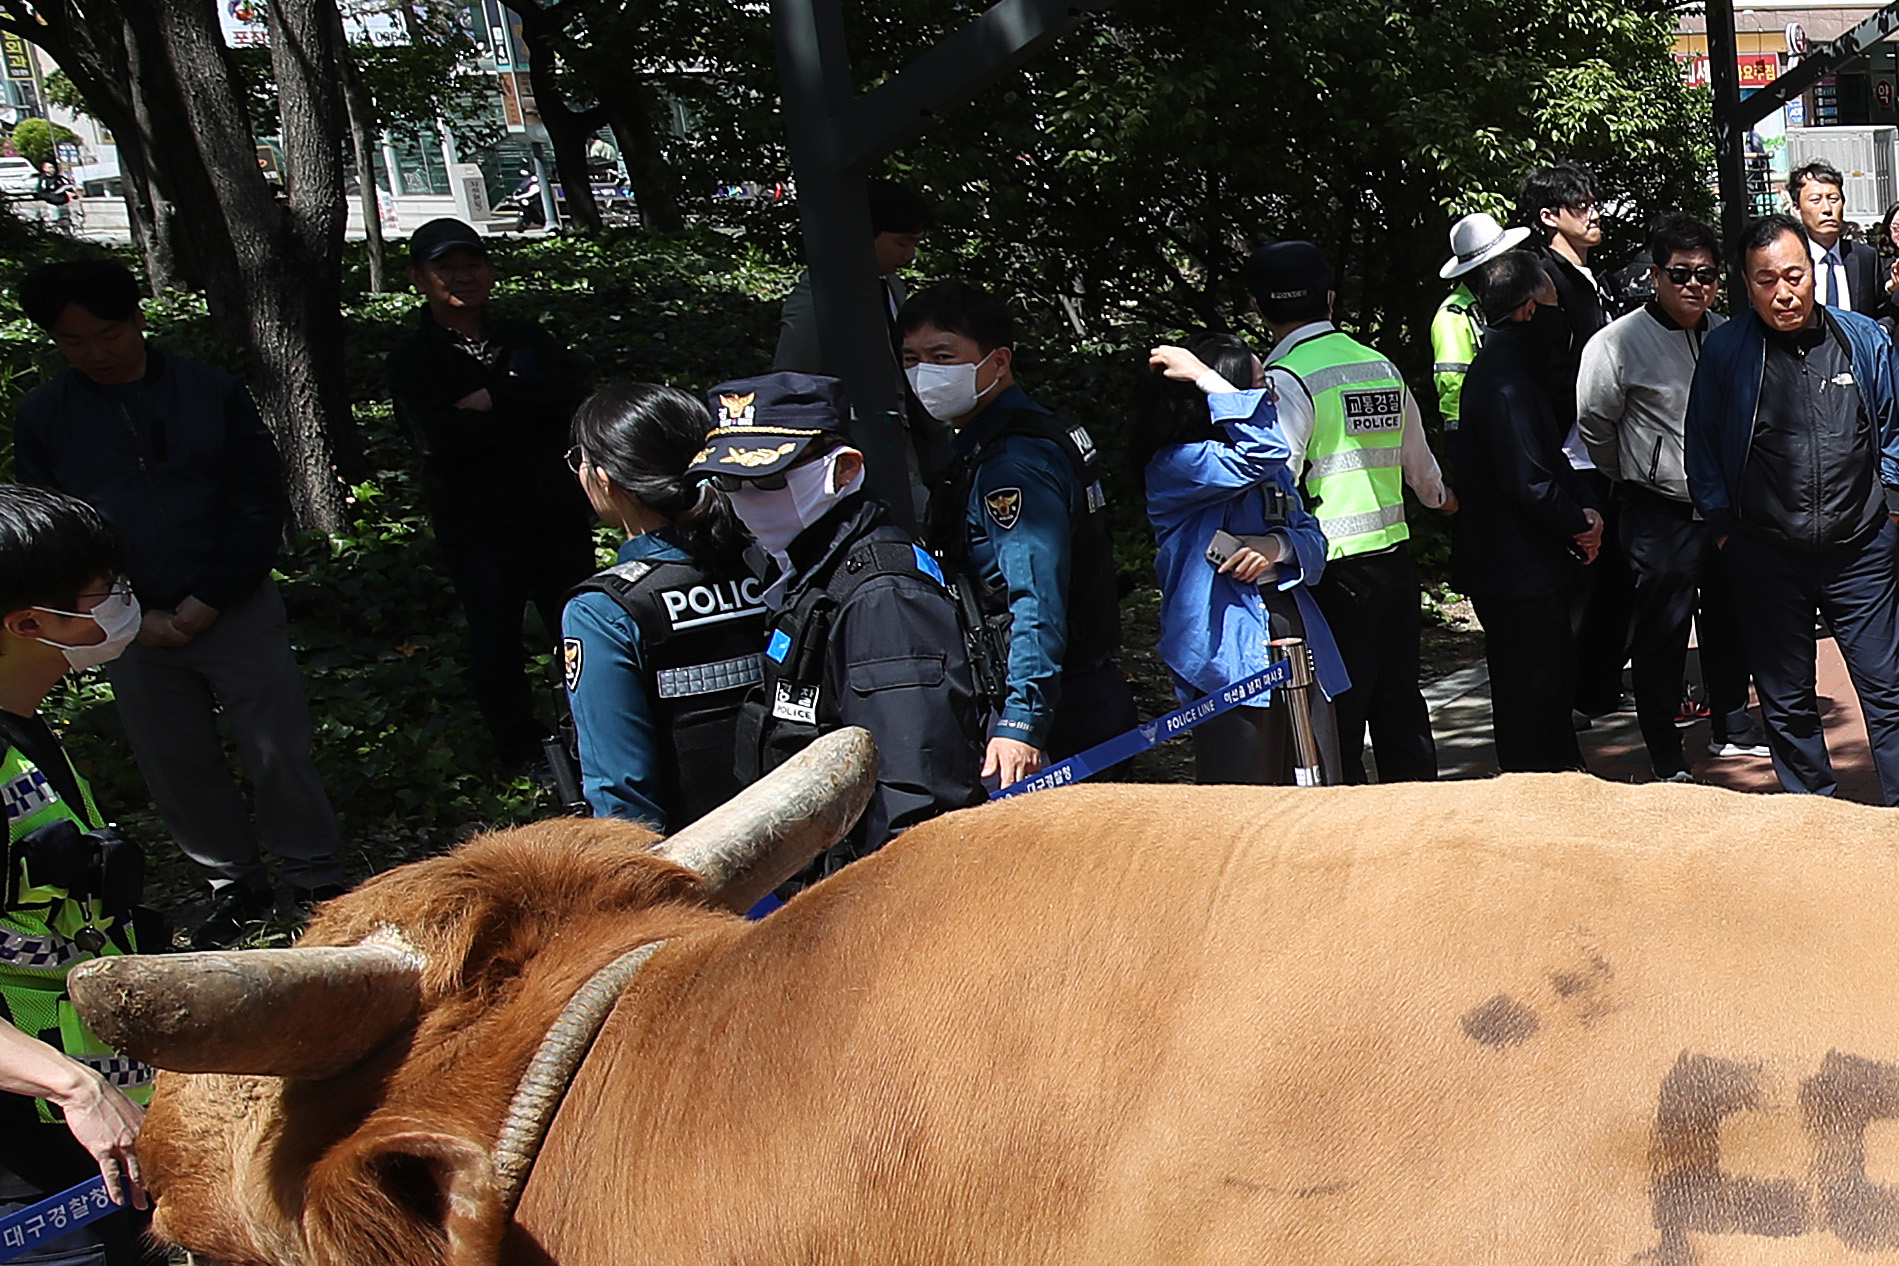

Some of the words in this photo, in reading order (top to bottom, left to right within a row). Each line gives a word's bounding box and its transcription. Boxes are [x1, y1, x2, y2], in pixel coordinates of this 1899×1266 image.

[1878, 85, 1889, 104] 약
[1348, 393, 1399, 414] 교통경찰
[1353, 416, 1399, 430] POLICE
[661, 577, 763, 621] POLIC
[777, 706, 812, 720] POLICE
[1166, 708, 1197, 732] POLICE
[1198, 699, 1216, 718] LINE
[2, 1185, 110, 1247] 대구경찰청
